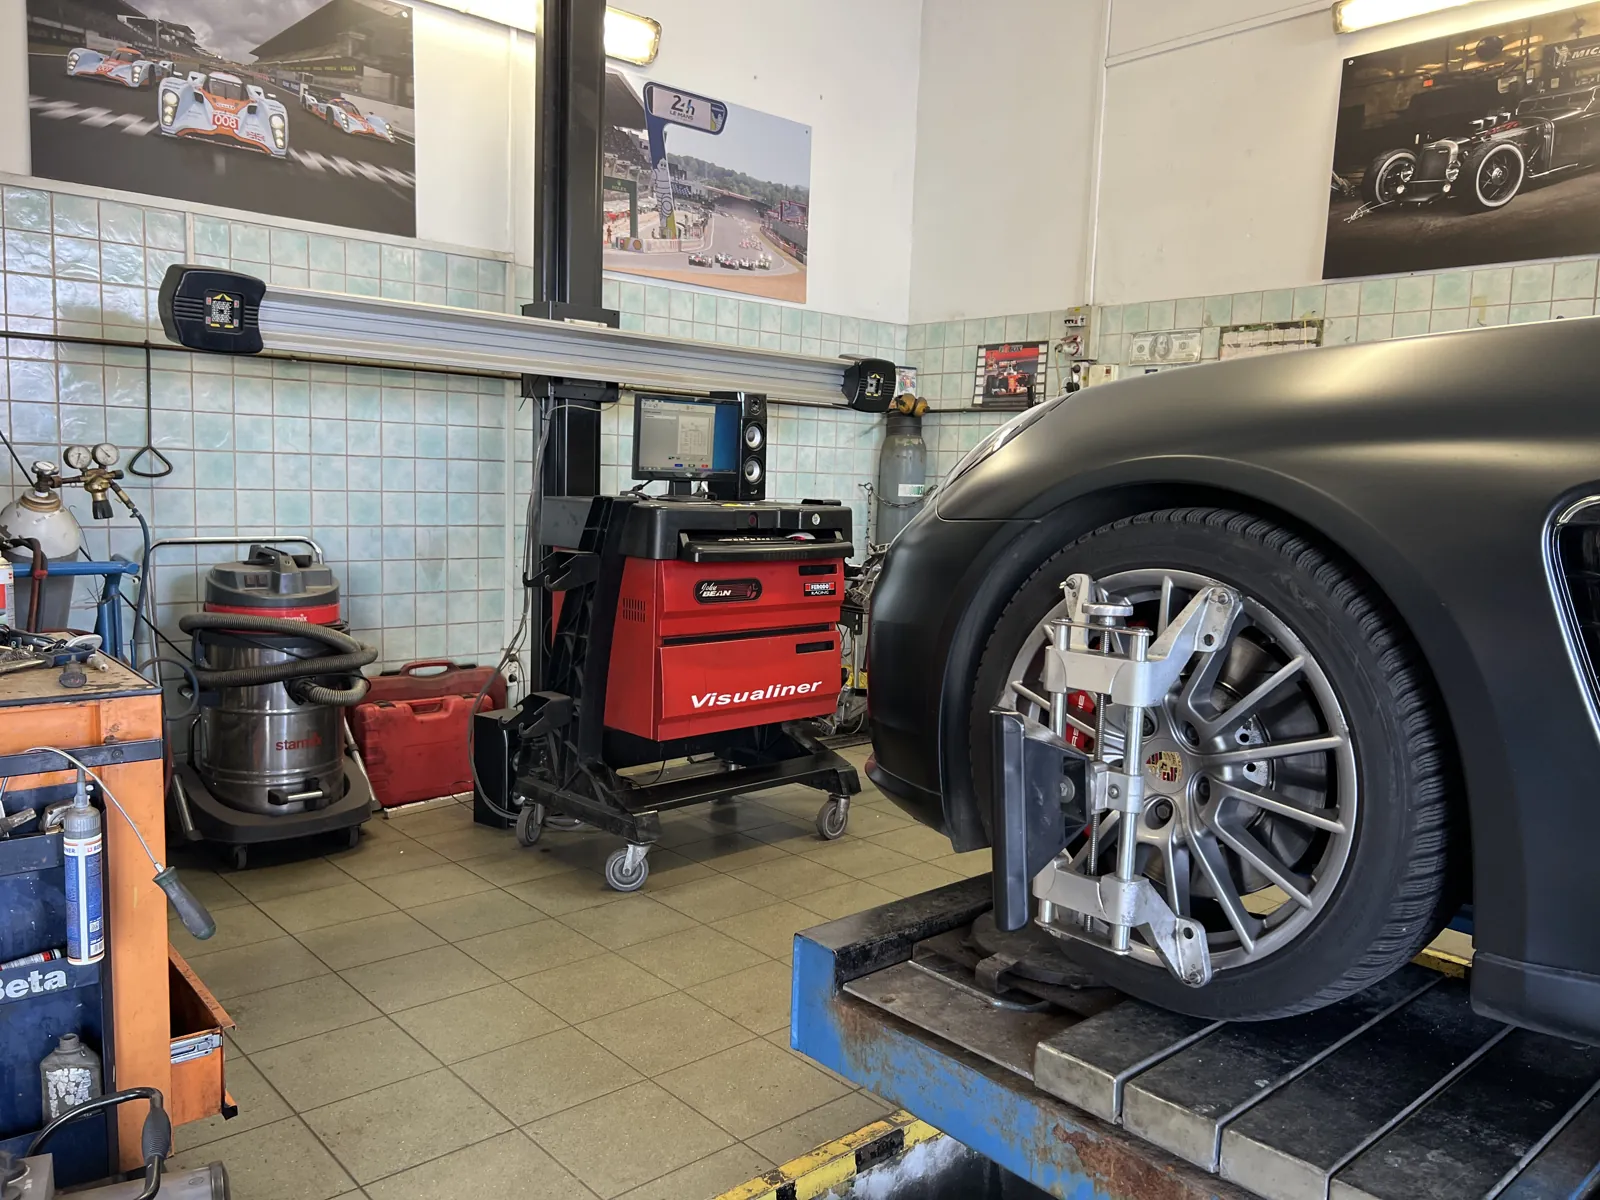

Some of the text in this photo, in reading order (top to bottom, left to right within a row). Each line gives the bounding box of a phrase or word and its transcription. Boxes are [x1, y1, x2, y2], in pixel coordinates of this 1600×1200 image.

[669, 109, 694, 120] LE MANS
[214, 115, 237, 128] 008
[691, 681, 822, 708] Visualiner
